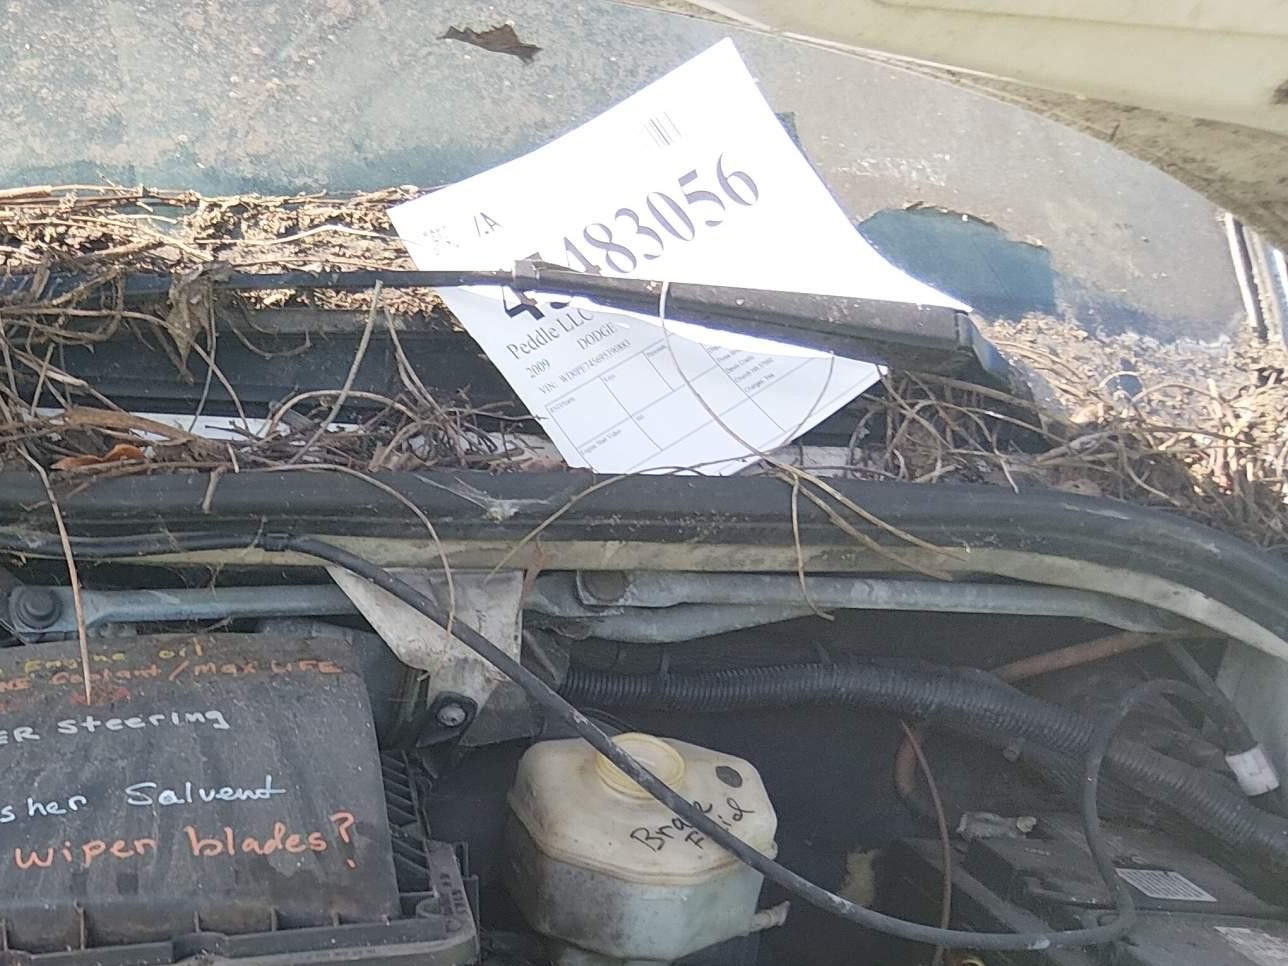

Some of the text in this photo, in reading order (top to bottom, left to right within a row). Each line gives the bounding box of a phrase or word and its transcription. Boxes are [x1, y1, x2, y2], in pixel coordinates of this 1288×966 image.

[506, 308, 594, 360] Peddle LLC
[525, 358, 551, 379] 2009
[576, 321, 617, 350] DODGE
[24, 653, 126, 674] Engne
[125, 775, 286, 806] Salvent
[184, 812, 357, 870] blades?
